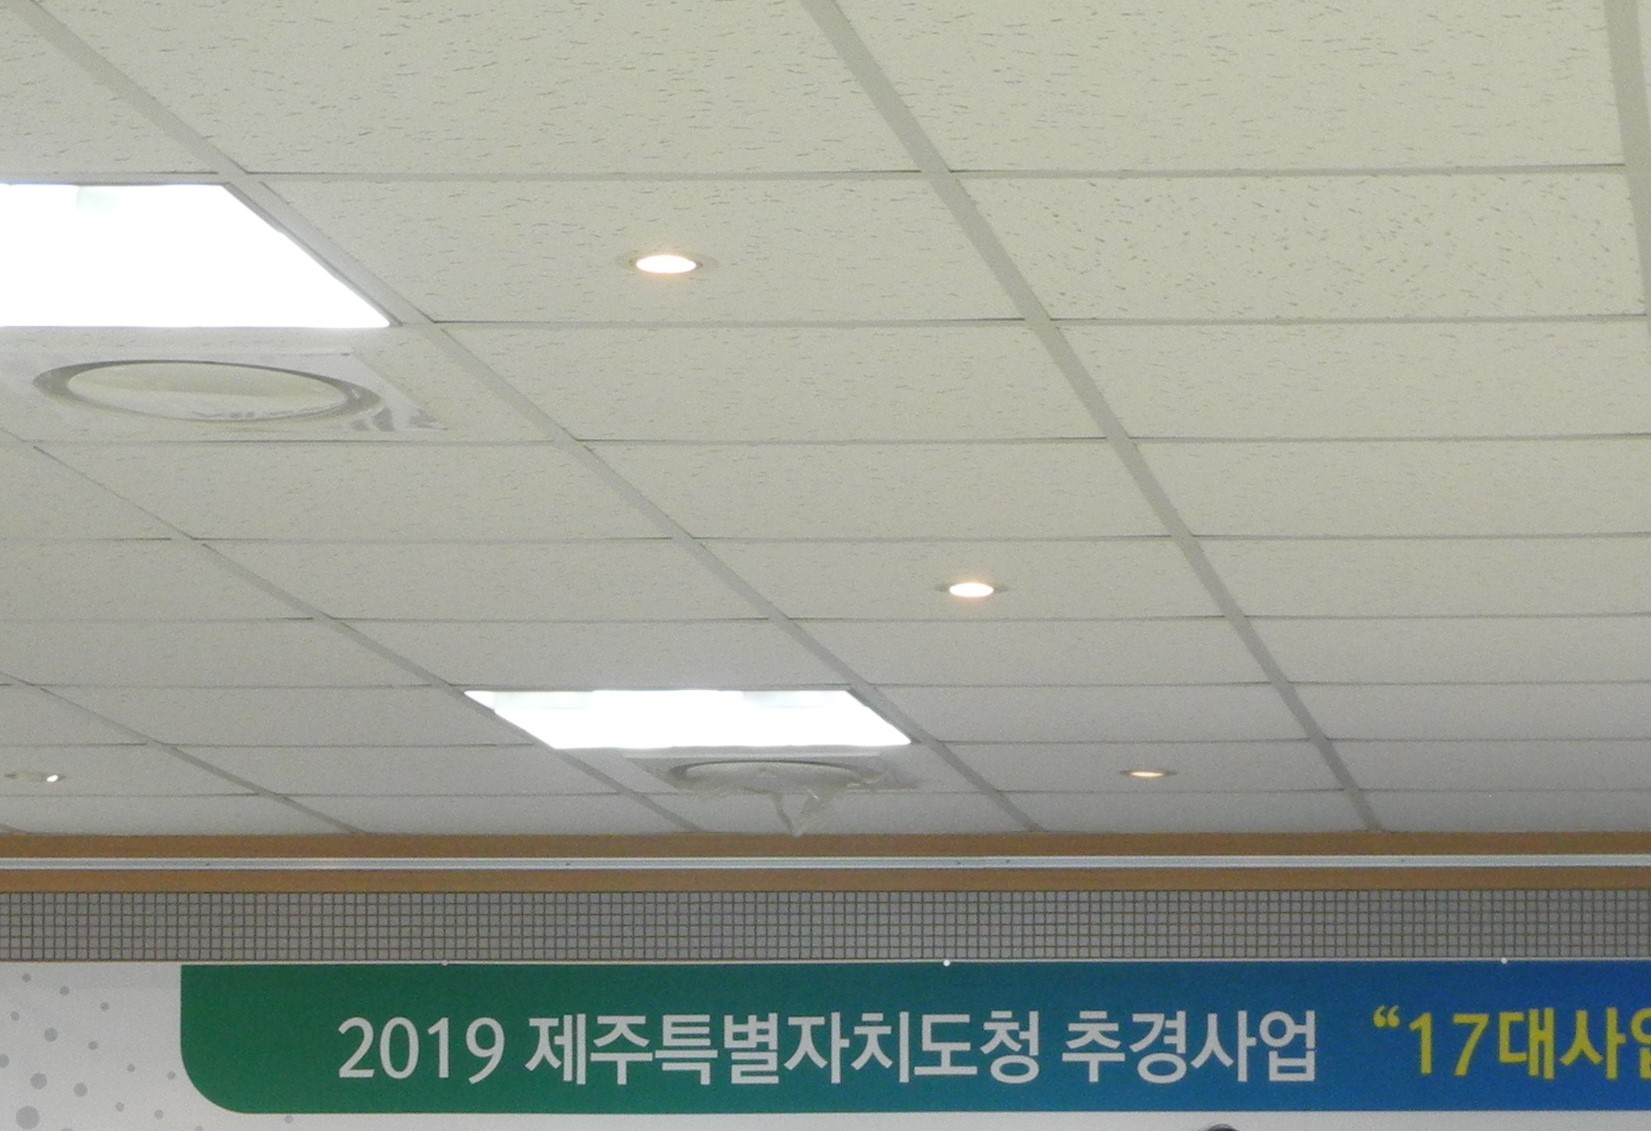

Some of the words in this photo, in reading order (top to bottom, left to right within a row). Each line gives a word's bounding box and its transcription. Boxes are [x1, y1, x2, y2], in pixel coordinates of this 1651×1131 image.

[337, 1015, 506, 1085] 2019
[524, 1009, 1041, 1087] 제주특별자치도청
[1060, 1009, 1318, 1086] 추경사업
